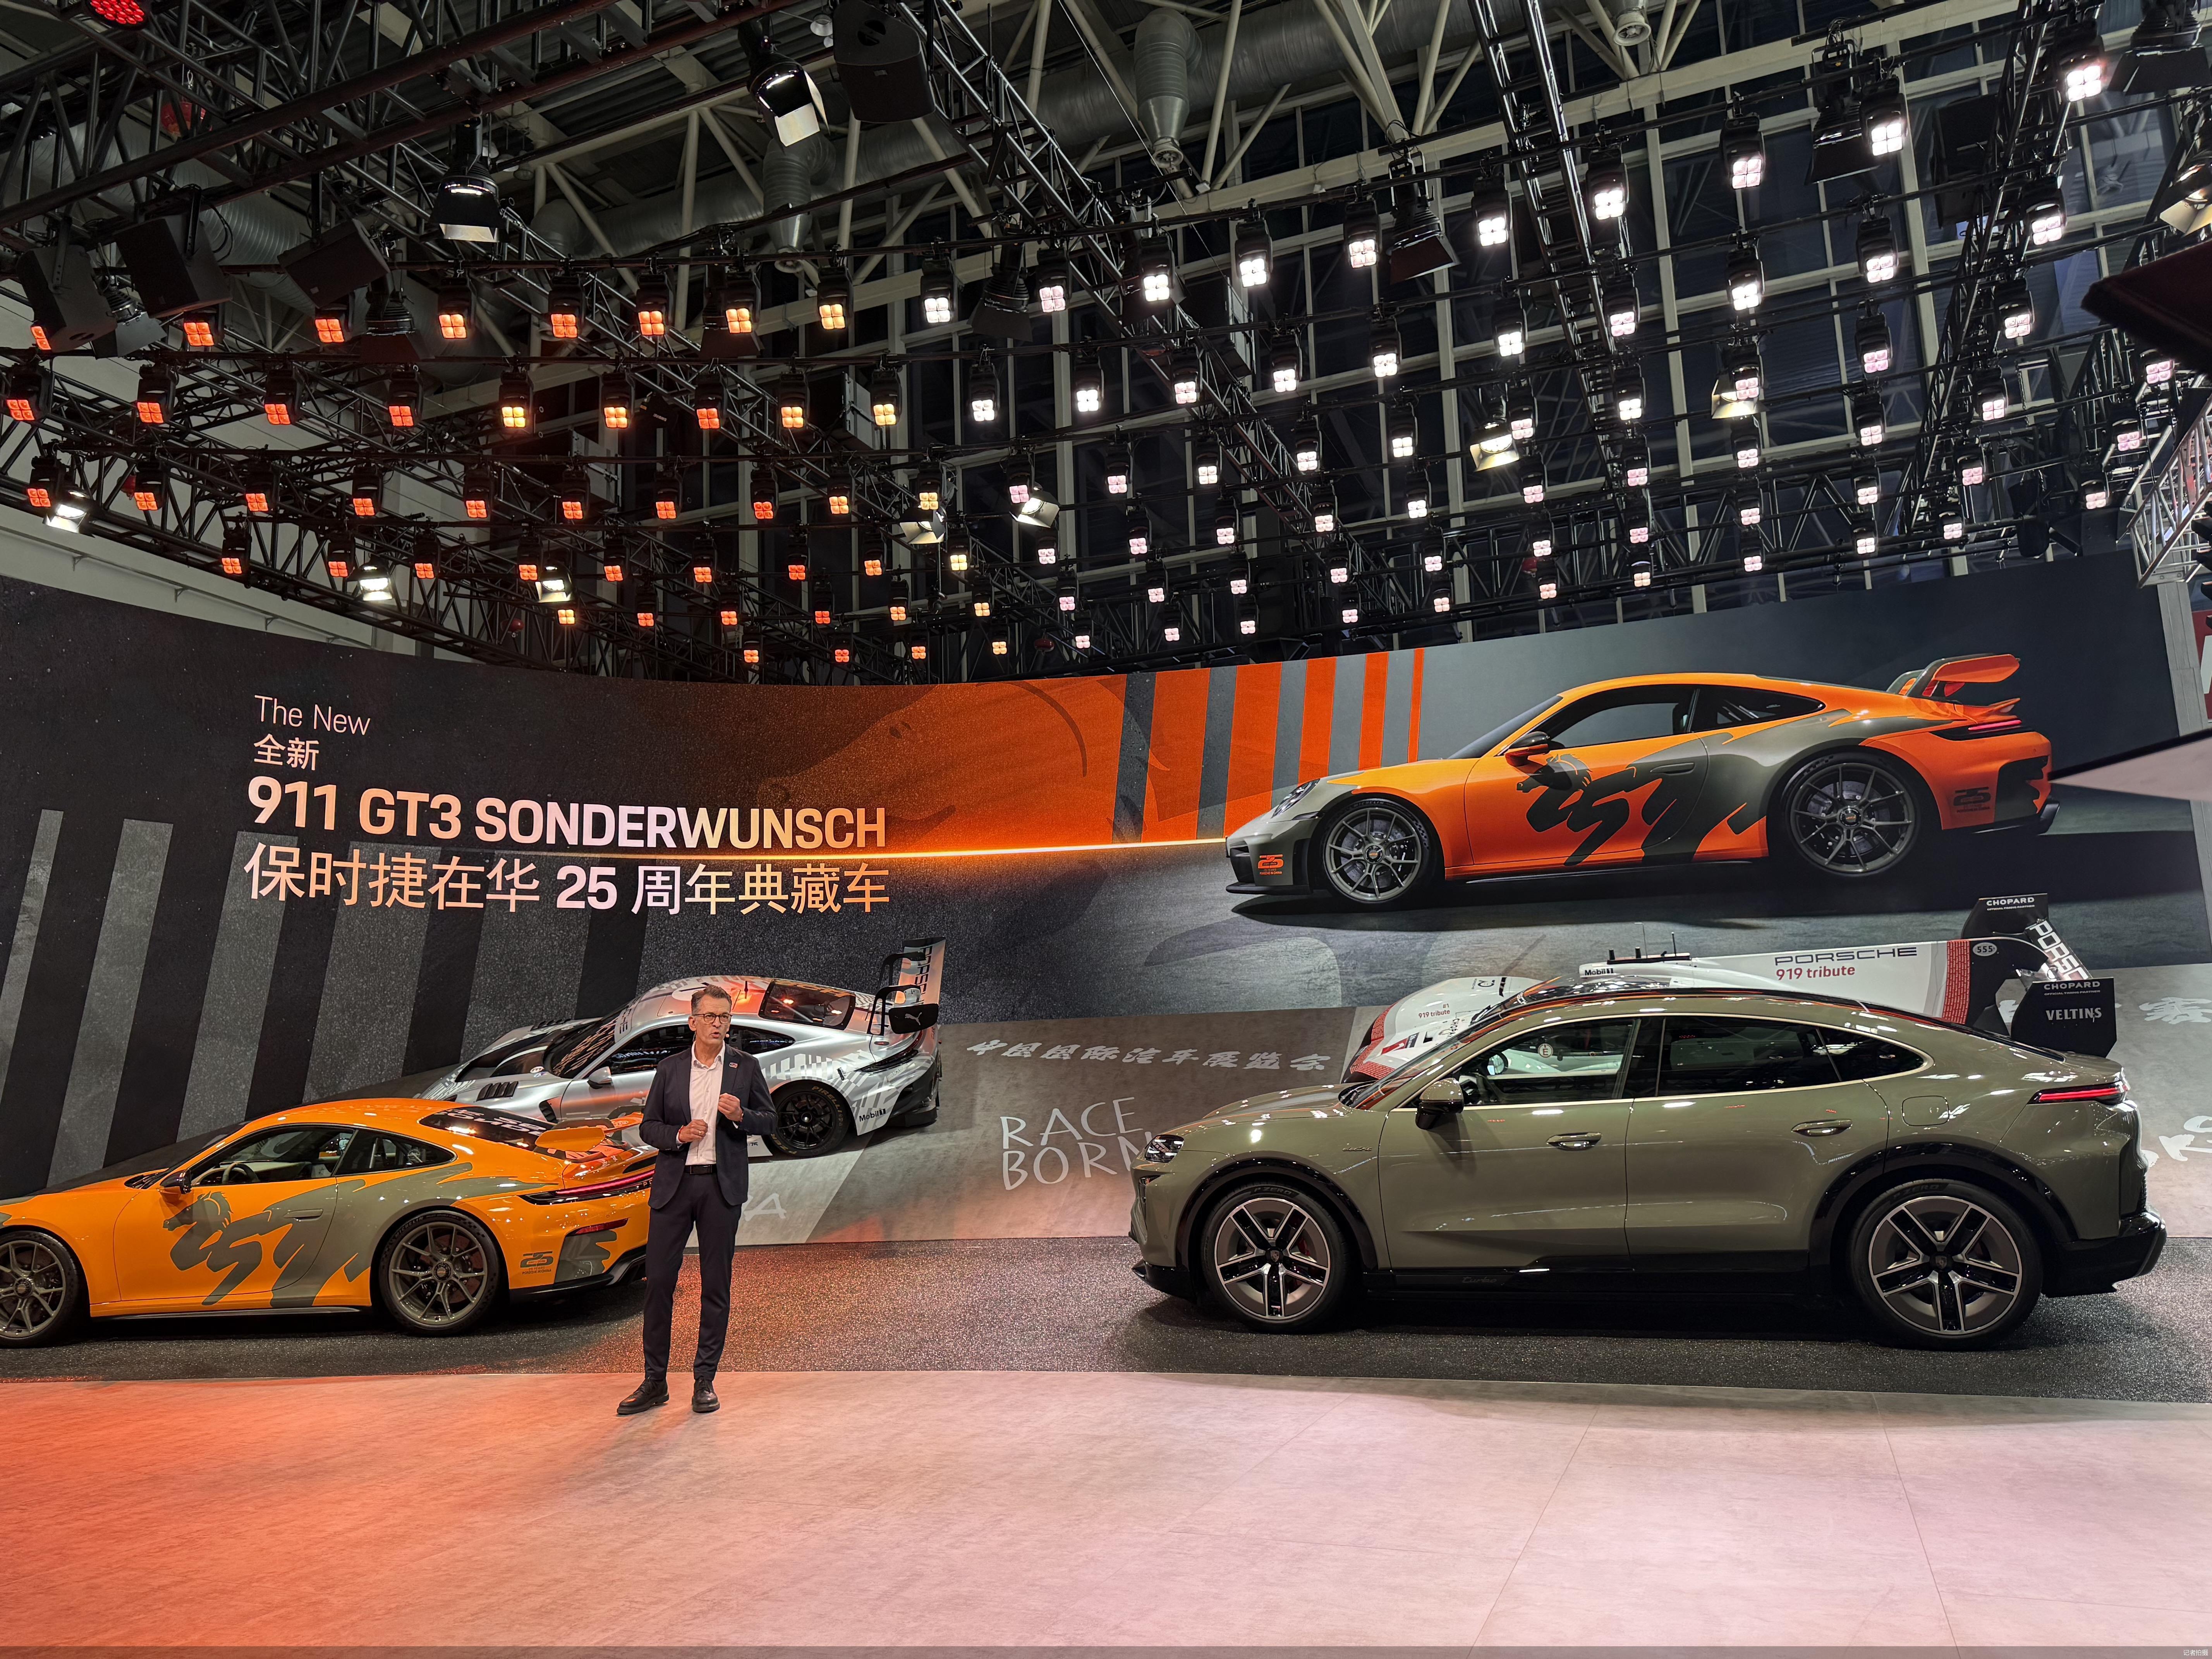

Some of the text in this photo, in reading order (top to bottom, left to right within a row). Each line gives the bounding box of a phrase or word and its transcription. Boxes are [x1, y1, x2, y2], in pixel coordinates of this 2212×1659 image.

[254, 695, 370, 735] The New
[254, 733, 319, 771] 全新
[248, 776, 885, 850] 911 GT3 SONDERWUNSCH
[243, 842, 889, 915] 保时捷在华 25 周年典藏车
[1986, 897, 2035, 906] CHOPARD
[1774, 947, 1917, 966] PORSCHE
[1776, 966, 1855, 981] 919 tribute
[2044, 981, 2100, 990] CHOPARD
[2045, 1007, 2102, 1020] VELTINS
[967, 1039, 1331, 1070] 中国国际汽车展览会
[811, 1086, 843, 1114] PIRELLI
[859, 1110, 879, 1122] Mobil
[1001, 1097, 1143, 1149] RACE
[395, 1215, 424, 1237] MICHELIN
